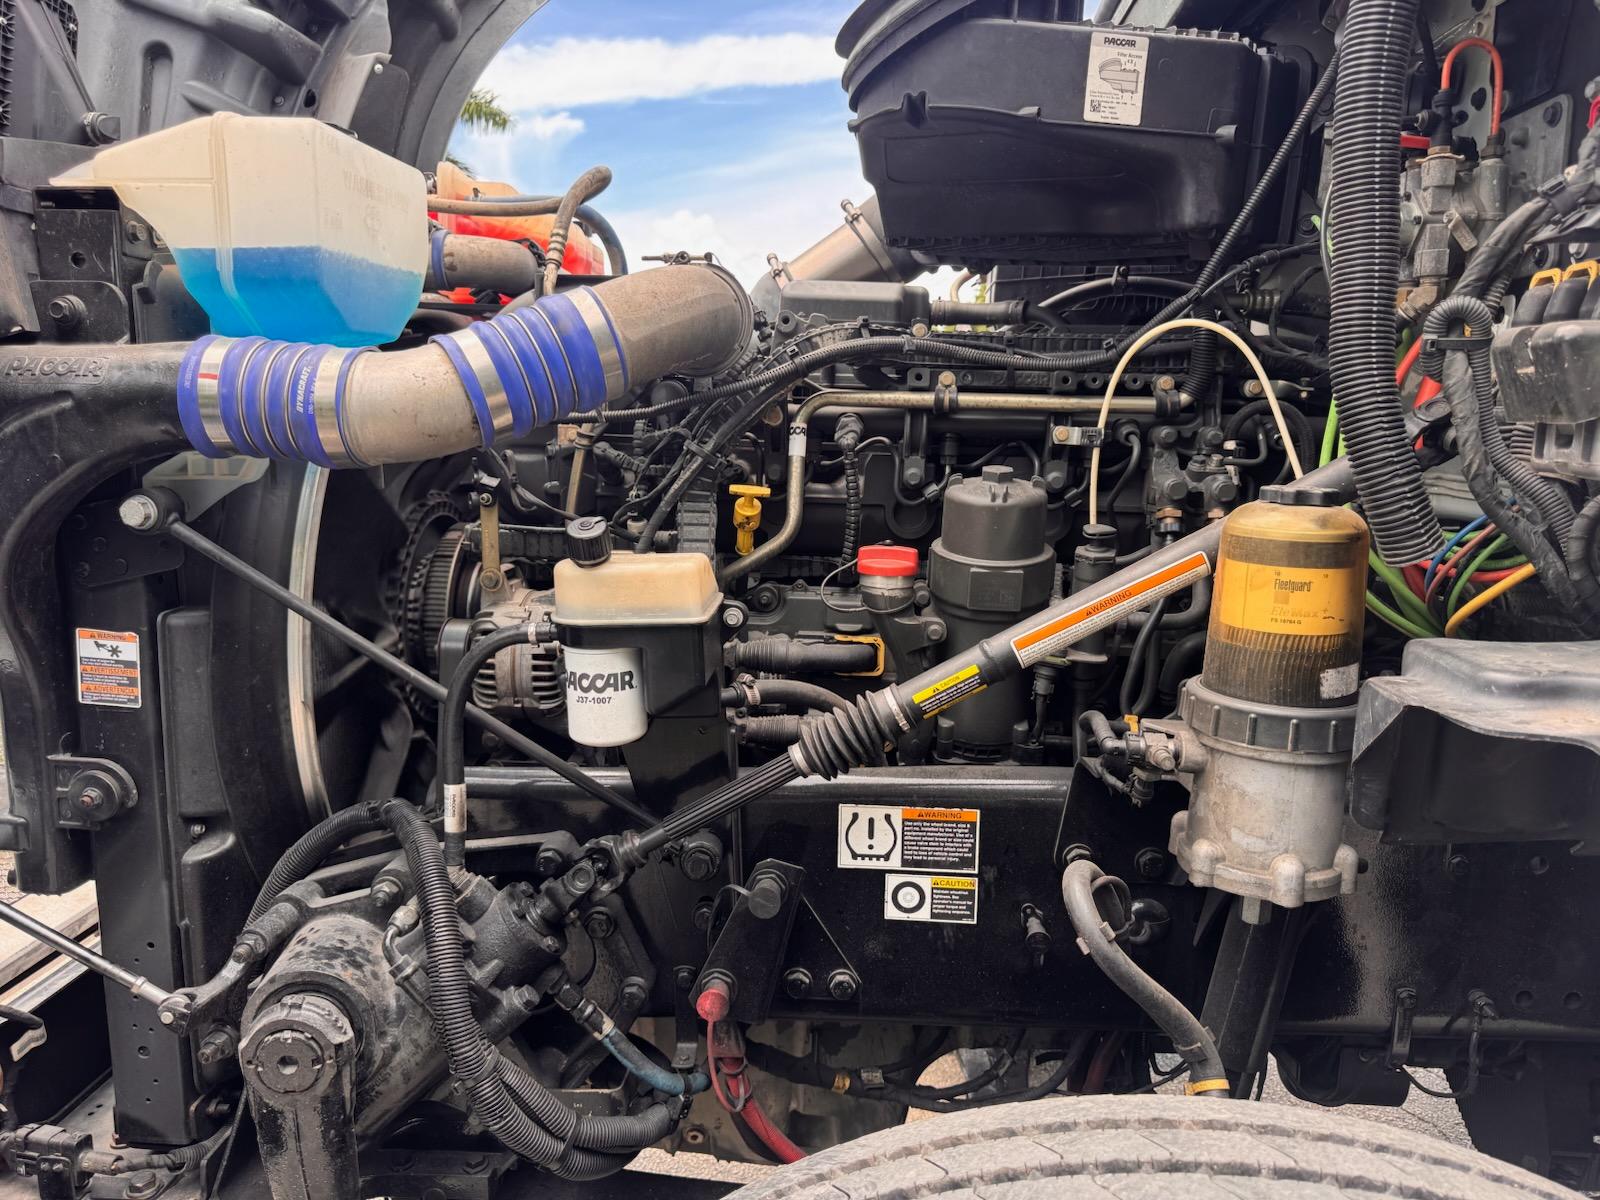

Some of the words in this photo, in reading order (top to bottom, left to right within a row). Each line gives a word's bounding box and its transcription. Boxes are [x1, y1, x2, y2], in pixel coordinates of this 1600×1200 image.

[1104, 37, 1136, 47] PACCAR
[5, 356, 103, 378] PACCAR
[1274, 578, 1312, 592] Fleetguard
[1090, 589, 1132, 614] WARNING
[567, 671, 634, 693] ACCAR
[576, 696, 612, 704] J37-1007
